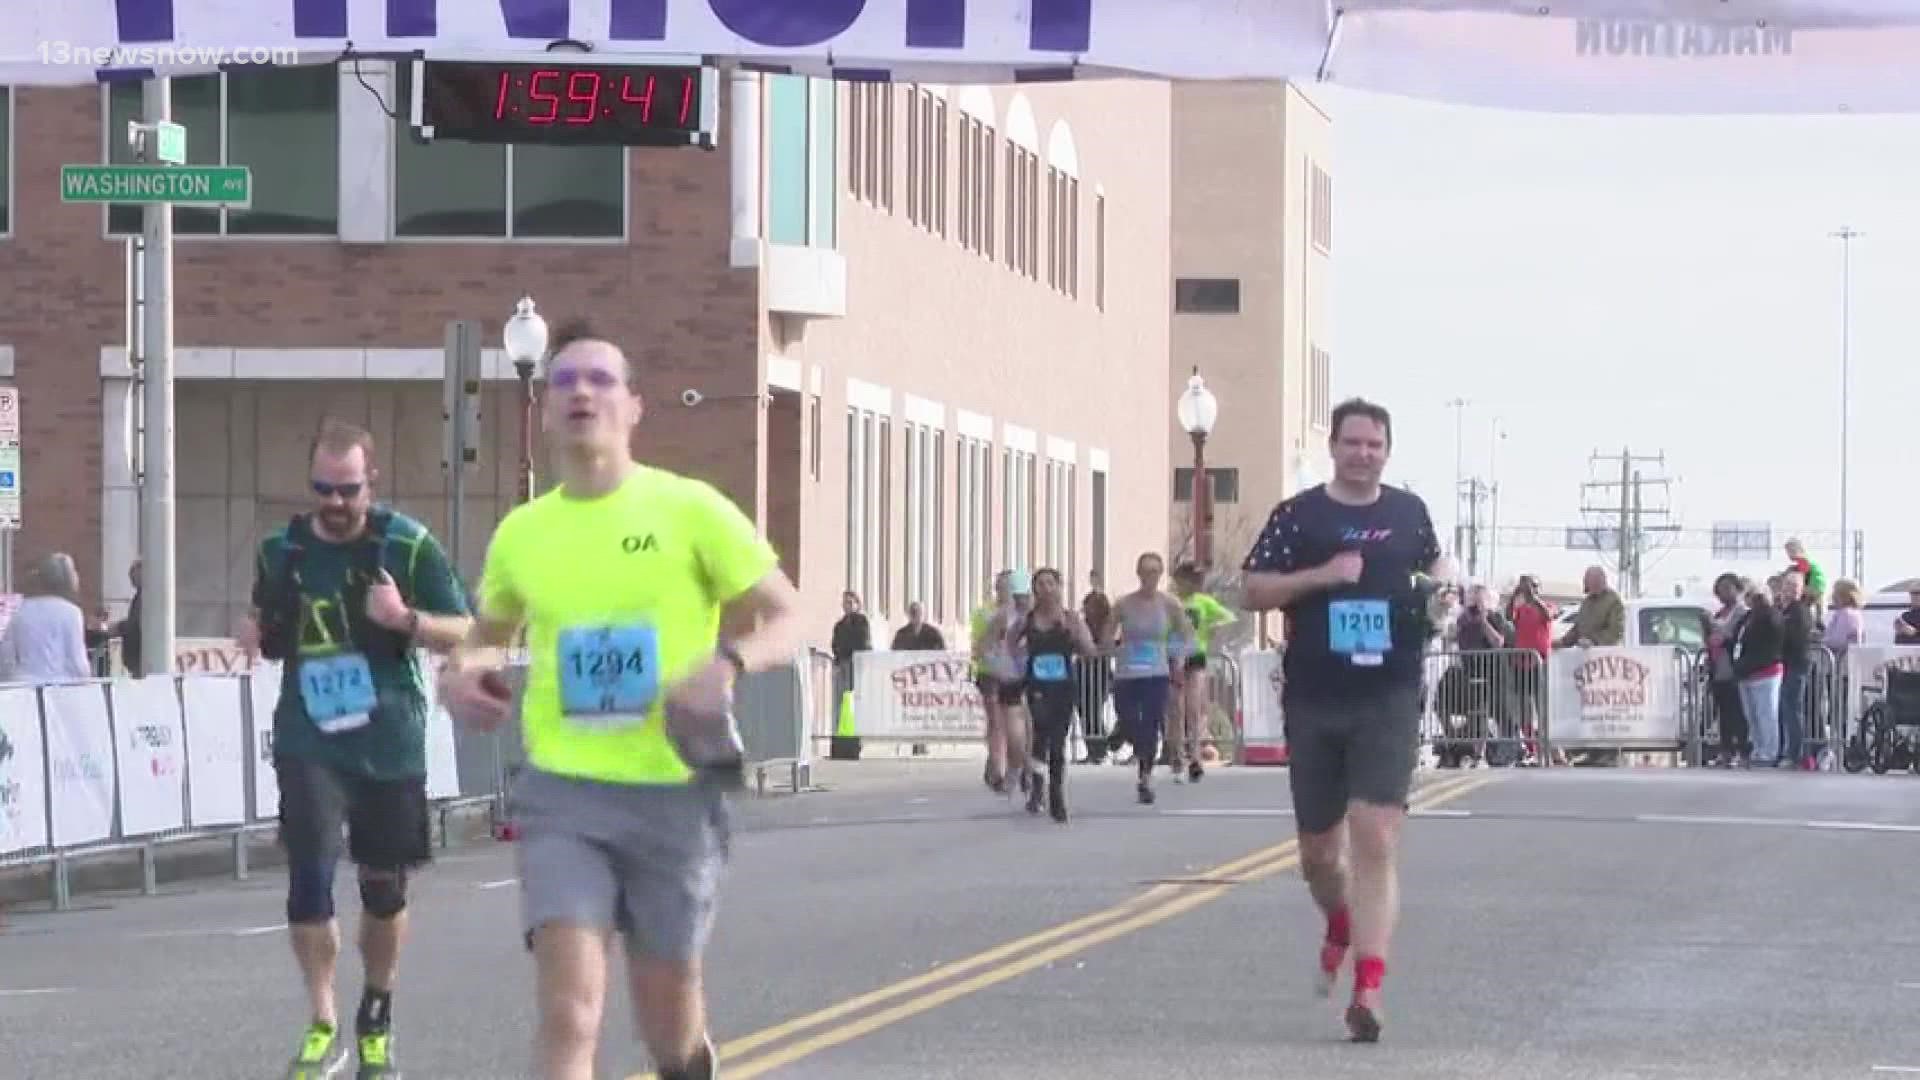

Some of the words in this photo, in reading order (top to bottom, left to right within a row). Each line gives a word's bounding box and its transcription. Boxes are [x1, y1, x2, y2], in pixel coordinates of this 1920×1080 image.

[494, 71, 693, 124] 1:59:41
[66, 173, 209, 194] WASHINGTON
[222, 178, 243, 191] AVE
[1340, 612, 1383, 632] 1210
[567, 646, 643, 678] 1294
[1574, 656, 1648, 690] SPIVEY
